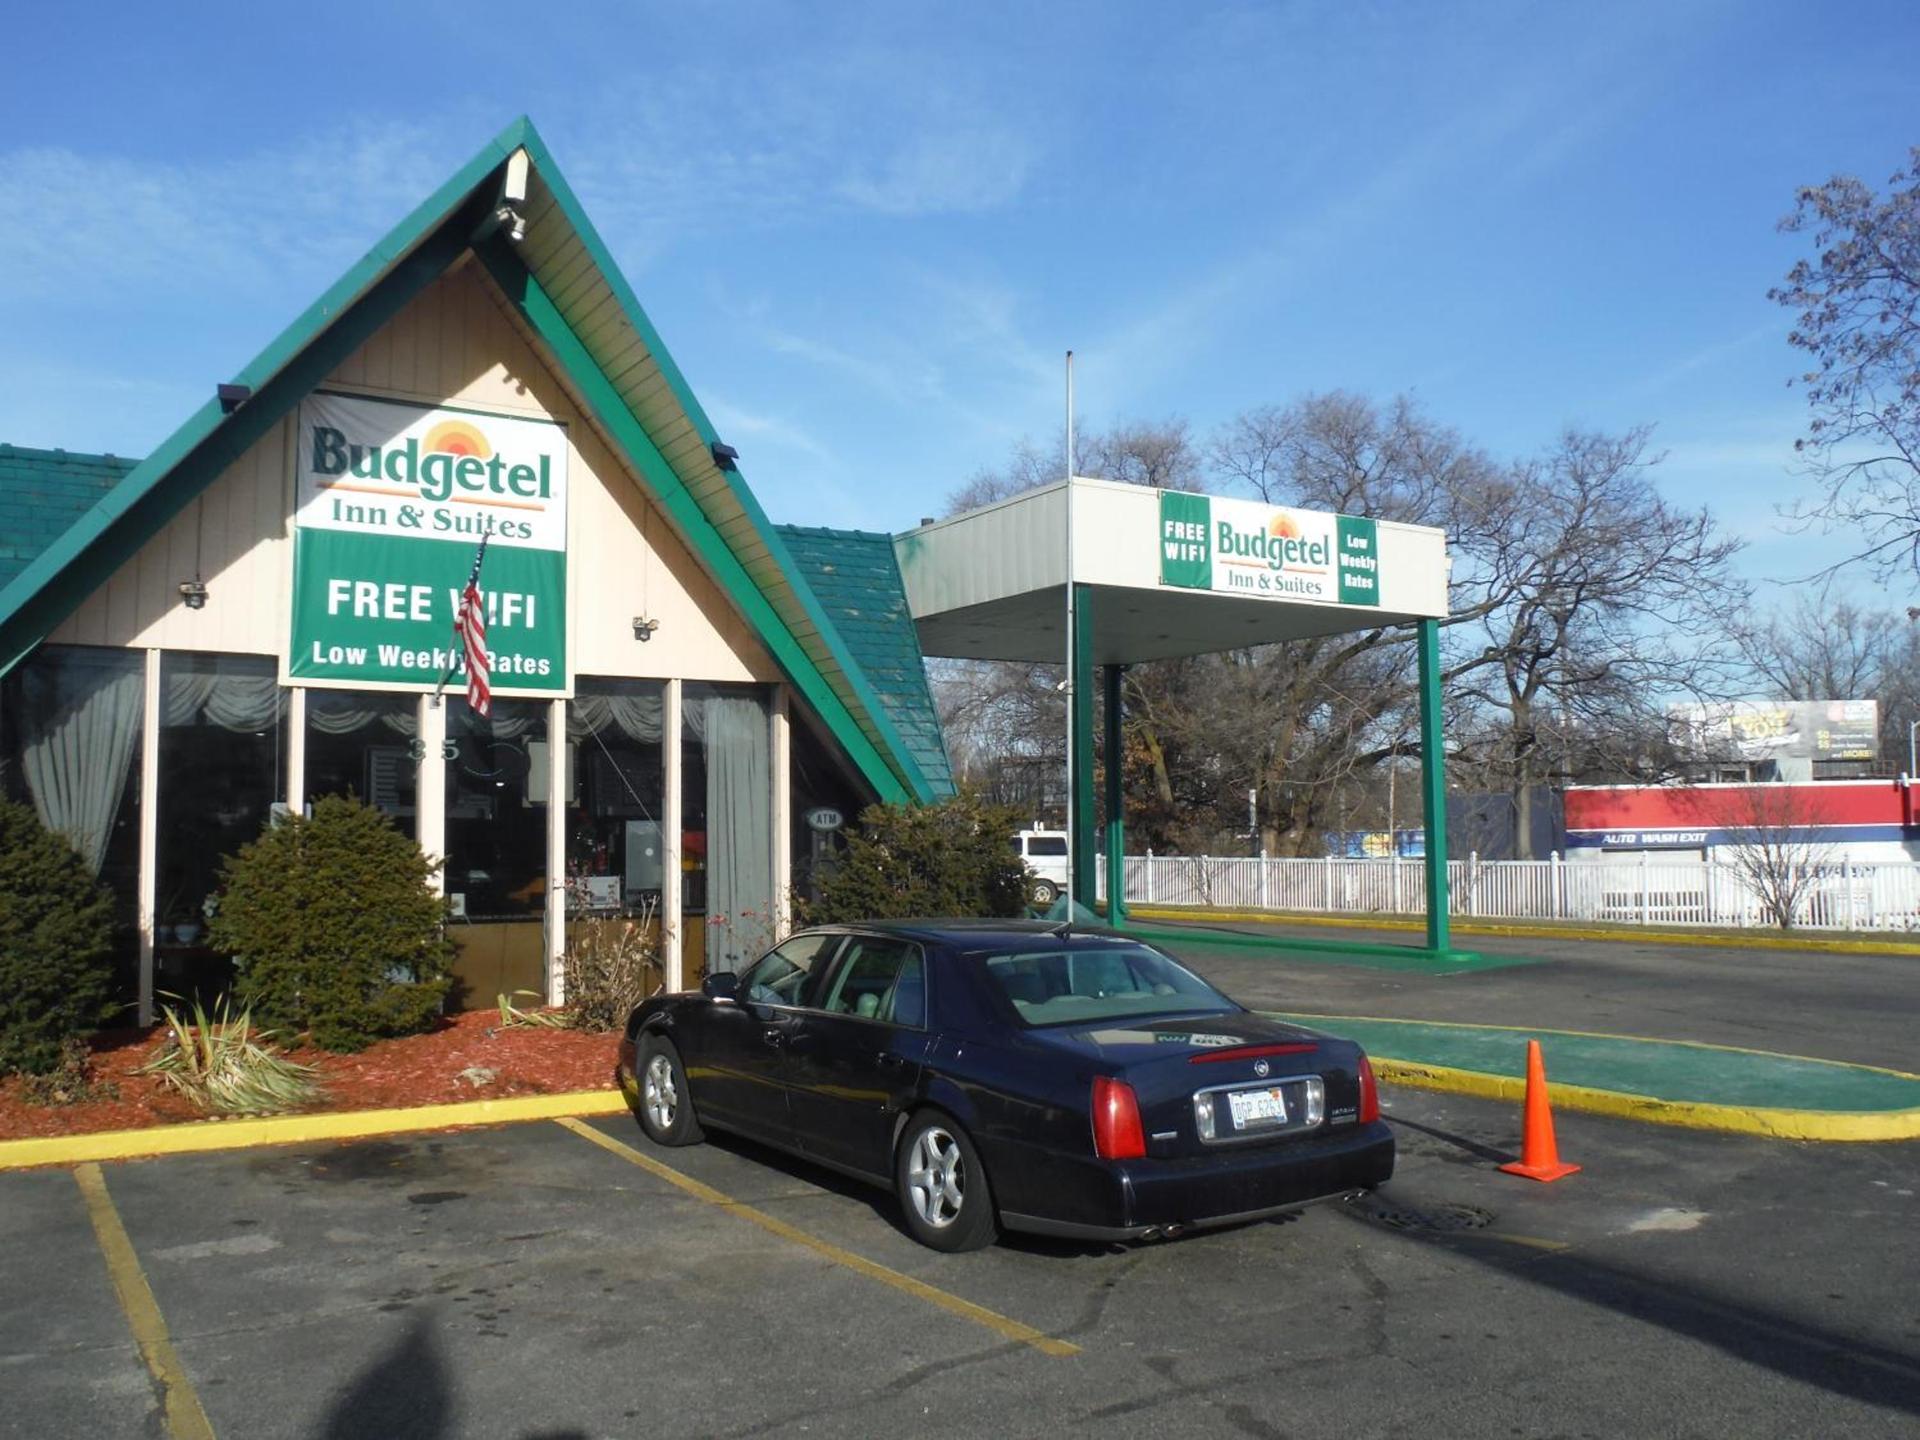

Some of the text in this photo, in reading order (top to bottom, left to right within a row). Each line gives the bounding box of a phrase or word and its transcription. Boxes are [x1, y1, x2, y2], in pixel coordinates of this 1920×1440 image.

[312, 425, 551, 501] Budgetel
[332, 498, 533, 540] Inn & Suites
[1164, 520, 1205, 541] FREE
[1217, 521, 1330, 571] Budgetel
[1346, 533, 1368, 550] Low
[1164, 542, 1206, 563] WIFI
[1339, 552, 1376, 572] Weekly
[1228, 571, 1322, 595] Inn & Suites
[1344, 573, 1374, 589] Rates
[327, 578, 433, 622] FREE
[312, 640, 368, 665] Low
[377, 644, 469, 675] Weekly
[816, 812, 837, 825] ATM
[1601, 832, 1709, 844] AUTO WASH EXIT
